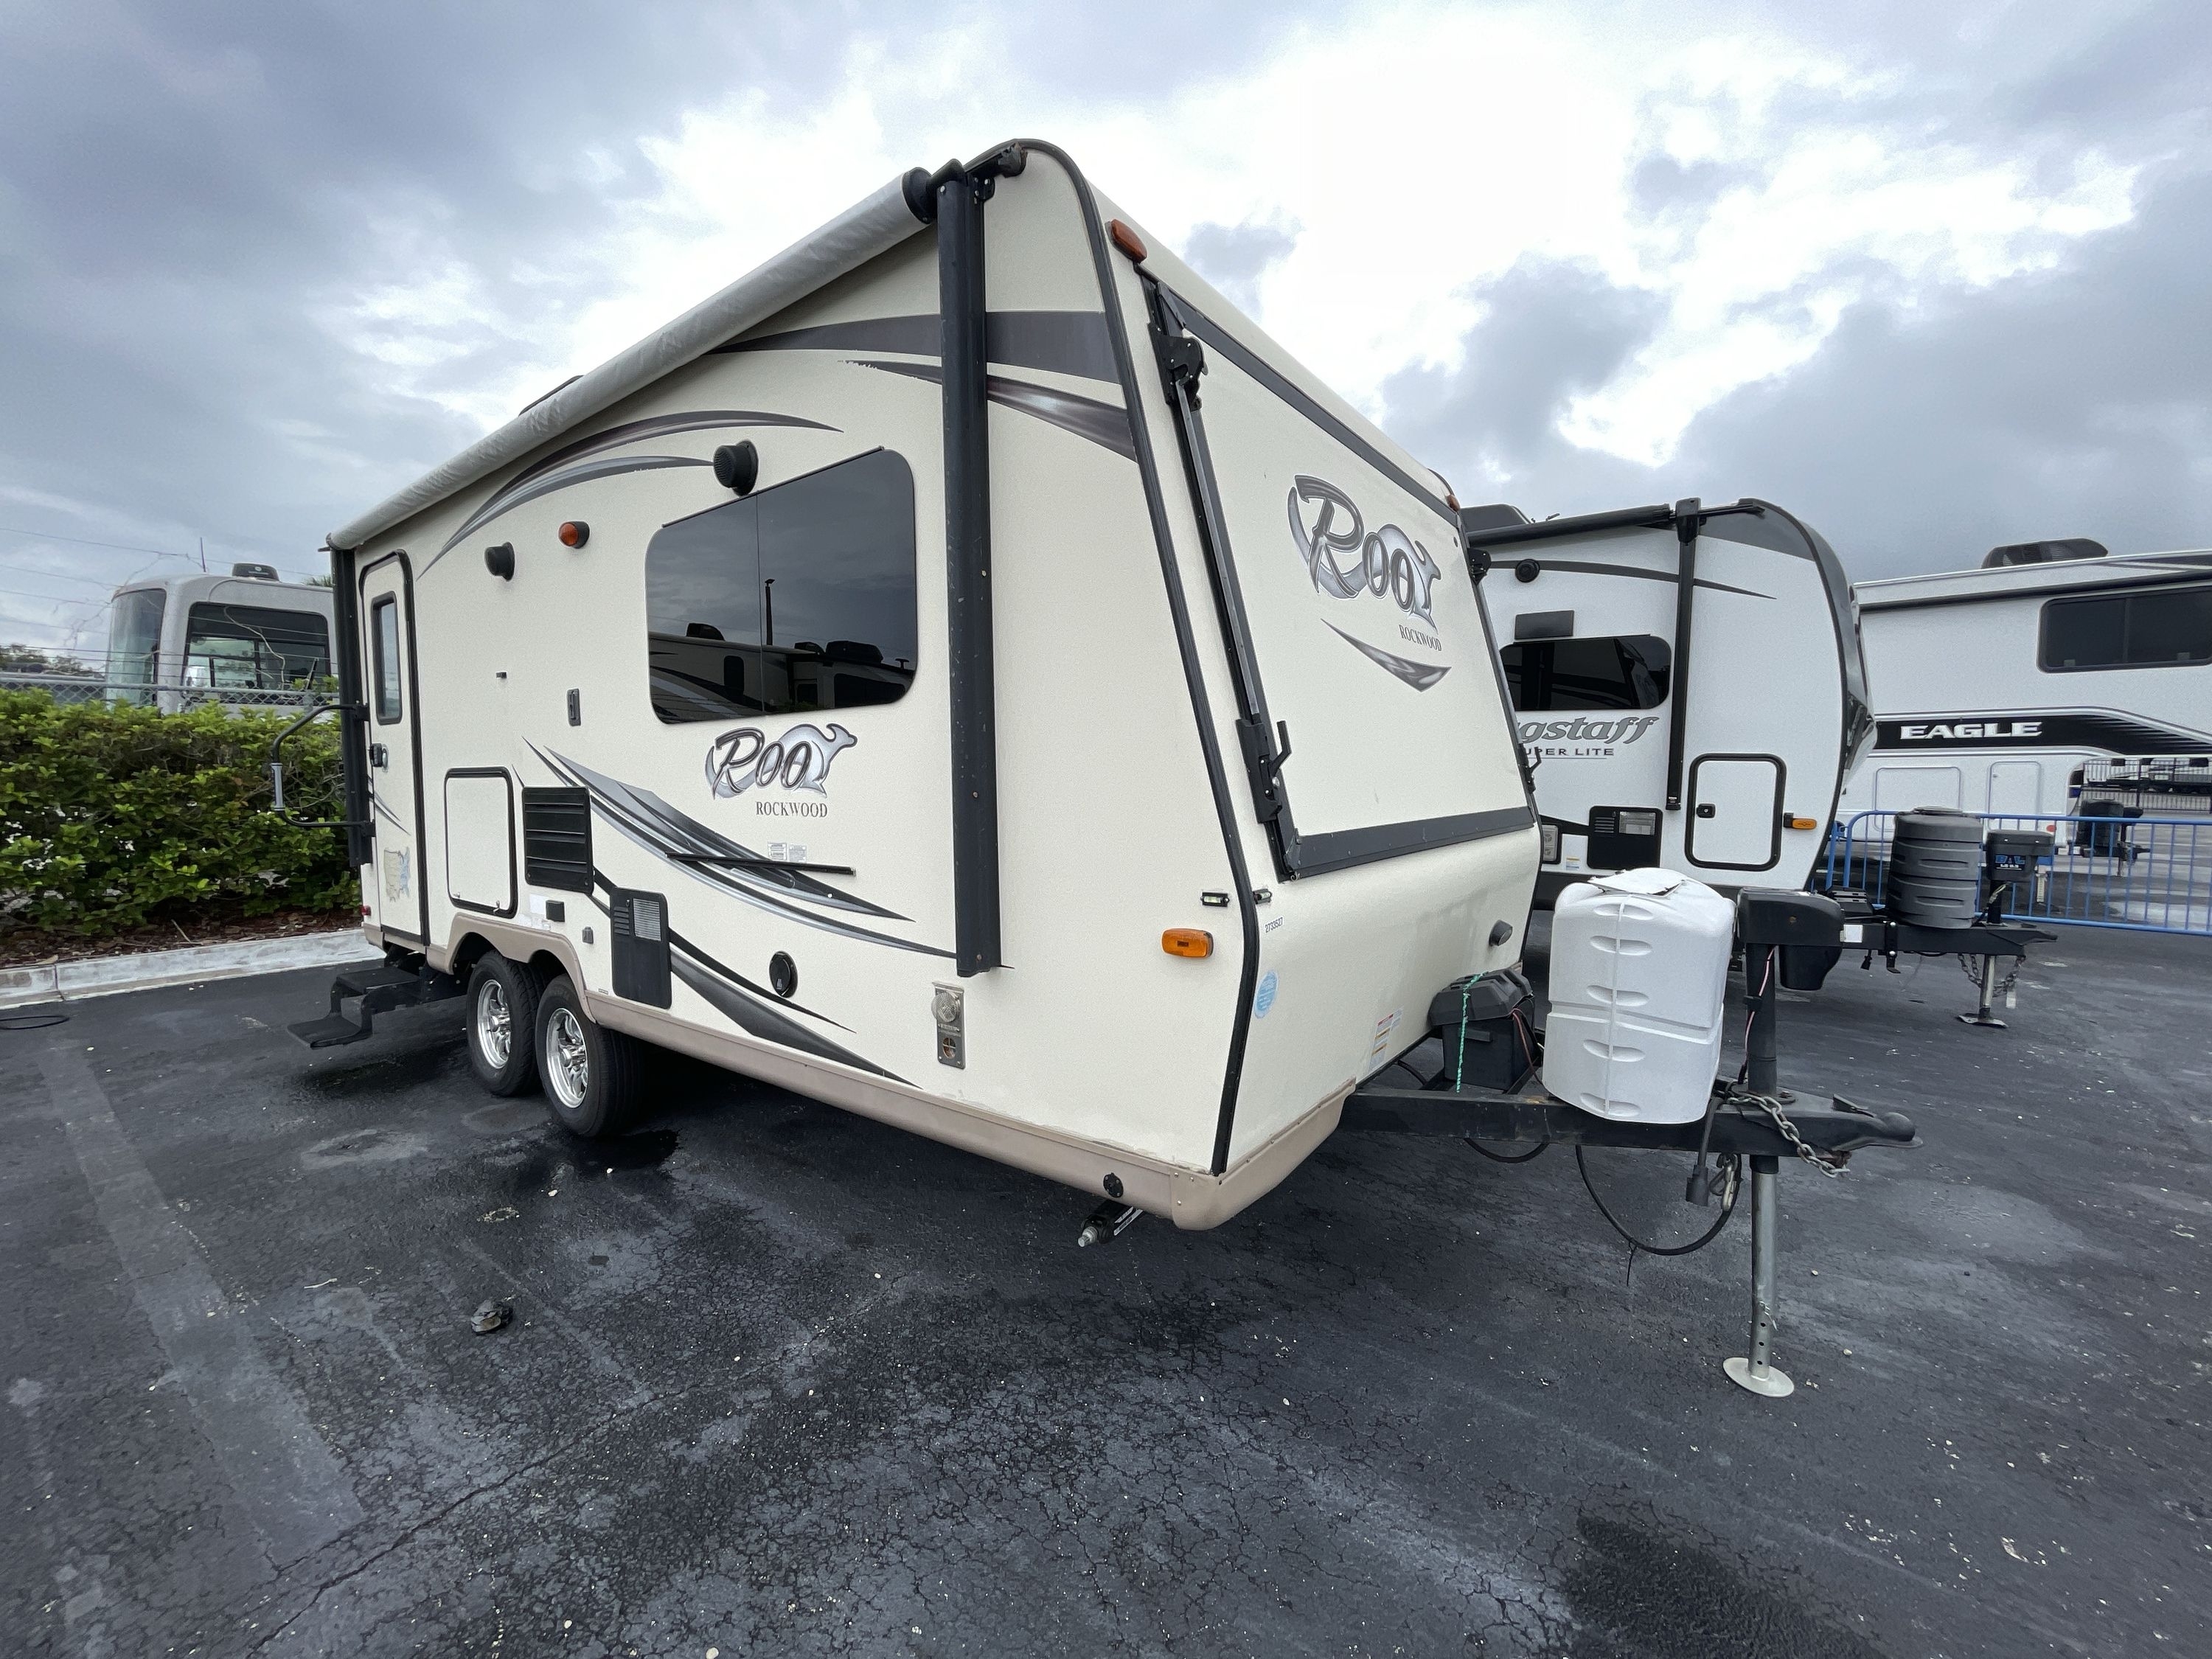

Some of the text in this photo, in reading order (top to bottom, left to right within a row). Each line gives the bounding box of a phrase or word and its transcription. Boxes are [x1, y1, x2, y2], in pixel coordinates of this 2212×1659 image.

[1399, 625, 1441, 650] ROCKWOOD
[1518, 717, 1659, 744] gstaff
[1900, 722, 2042, 740] EAGLE
[1526, 748, 1568, 756] UPER
[756, 801, 828, 818] ROCKWOOD
